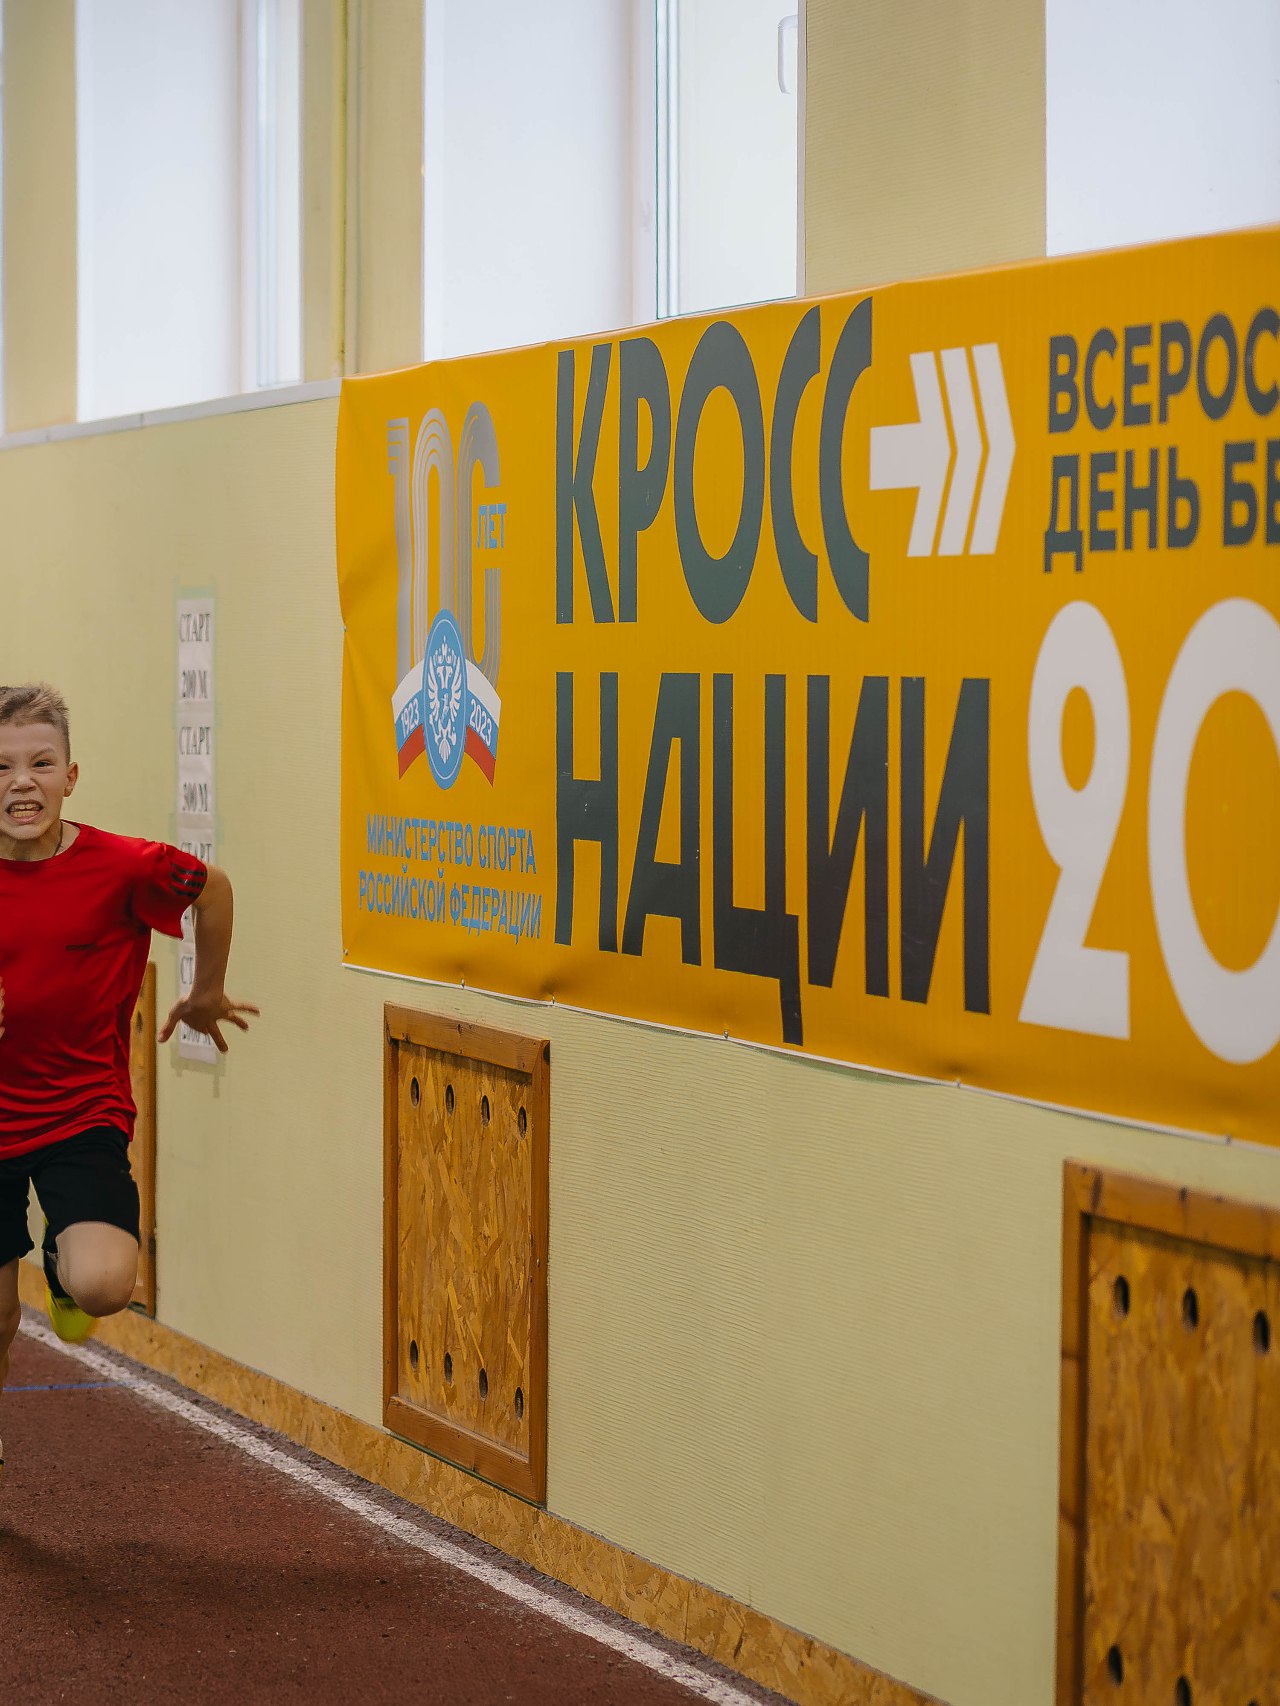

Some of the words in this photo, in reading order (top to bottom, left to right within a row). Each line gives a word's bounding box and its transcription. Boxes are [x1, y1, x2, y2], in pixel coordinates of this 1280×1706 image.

[1048, 305, 1280, 434] ВСЕРОС
[556, 296, 873, 625] КРОСС
[476, 503, 507, 549] ЛЕТ
[1043, 446, 1201, 573] ДЕНЬ
[179, 613, 210, 642] СТАРТ
[179, 727, 210, 755] СТАРТ
[401, 698, 419, 738] 1923
[469, 698, 492, 746] 2023
[367, 813, 474, 867] МИНИСТЕРСТВО
[478, 824, 537, 875] СПОРТА
[554, 671, 992, 1047] НАЦИИ
[359, 863, 446, 924] РОССИЙСКОЙ
[449, 882, 543, 944] ФЕДЕРАЦИИ
